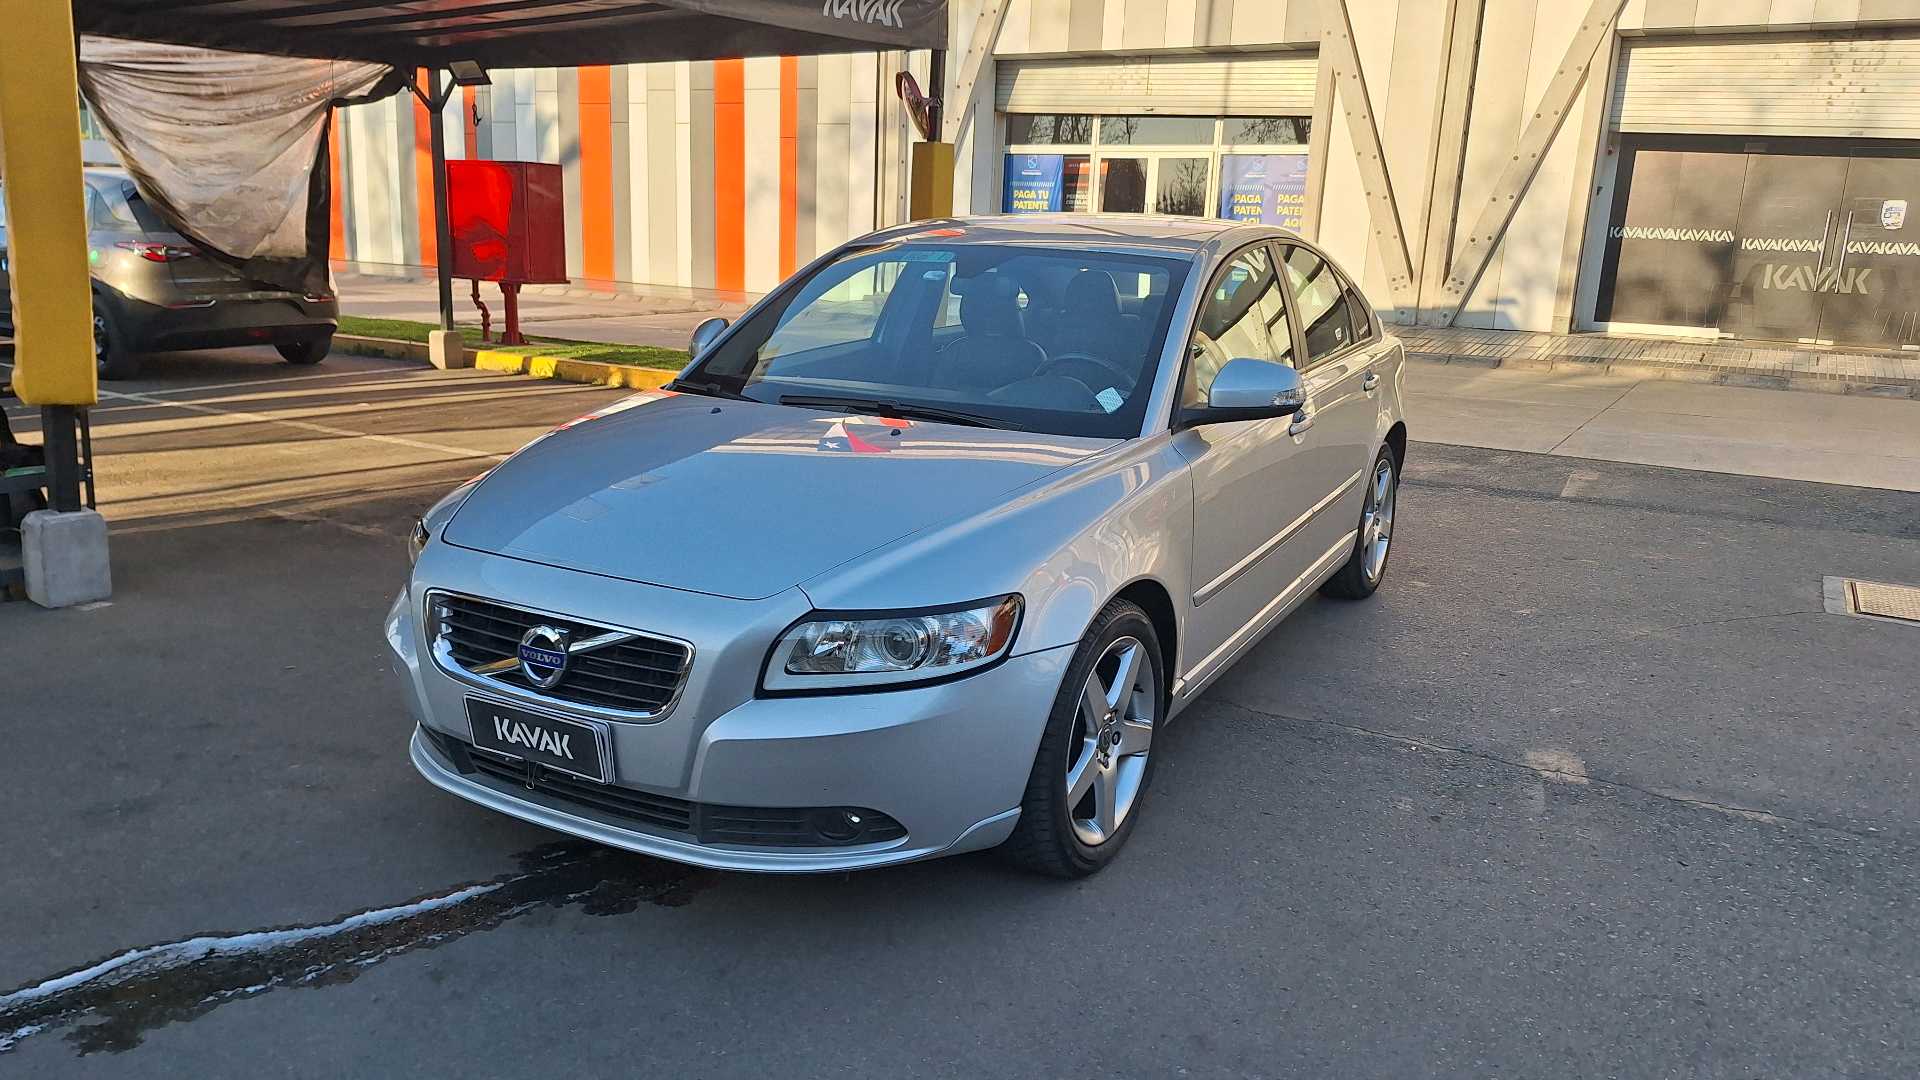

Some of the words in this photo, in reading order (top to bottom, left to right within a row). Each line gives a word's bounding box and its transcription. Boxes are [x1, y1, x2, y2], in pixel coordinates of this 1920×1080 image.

[1013, 190, 1037, 199] PAGA
[1038, 190, 1049, 199] TU
[1234, 194, 1261, 203] PAGA
[1278, 194, 1304, 203] PAGA
[1014, 201, 1048, 210] PATENTE
[1763, 263, 1872, 294] KAVAK
[521, 648, 561, 665] VOLVO
[493, 716, 574, 760] KAVAK
